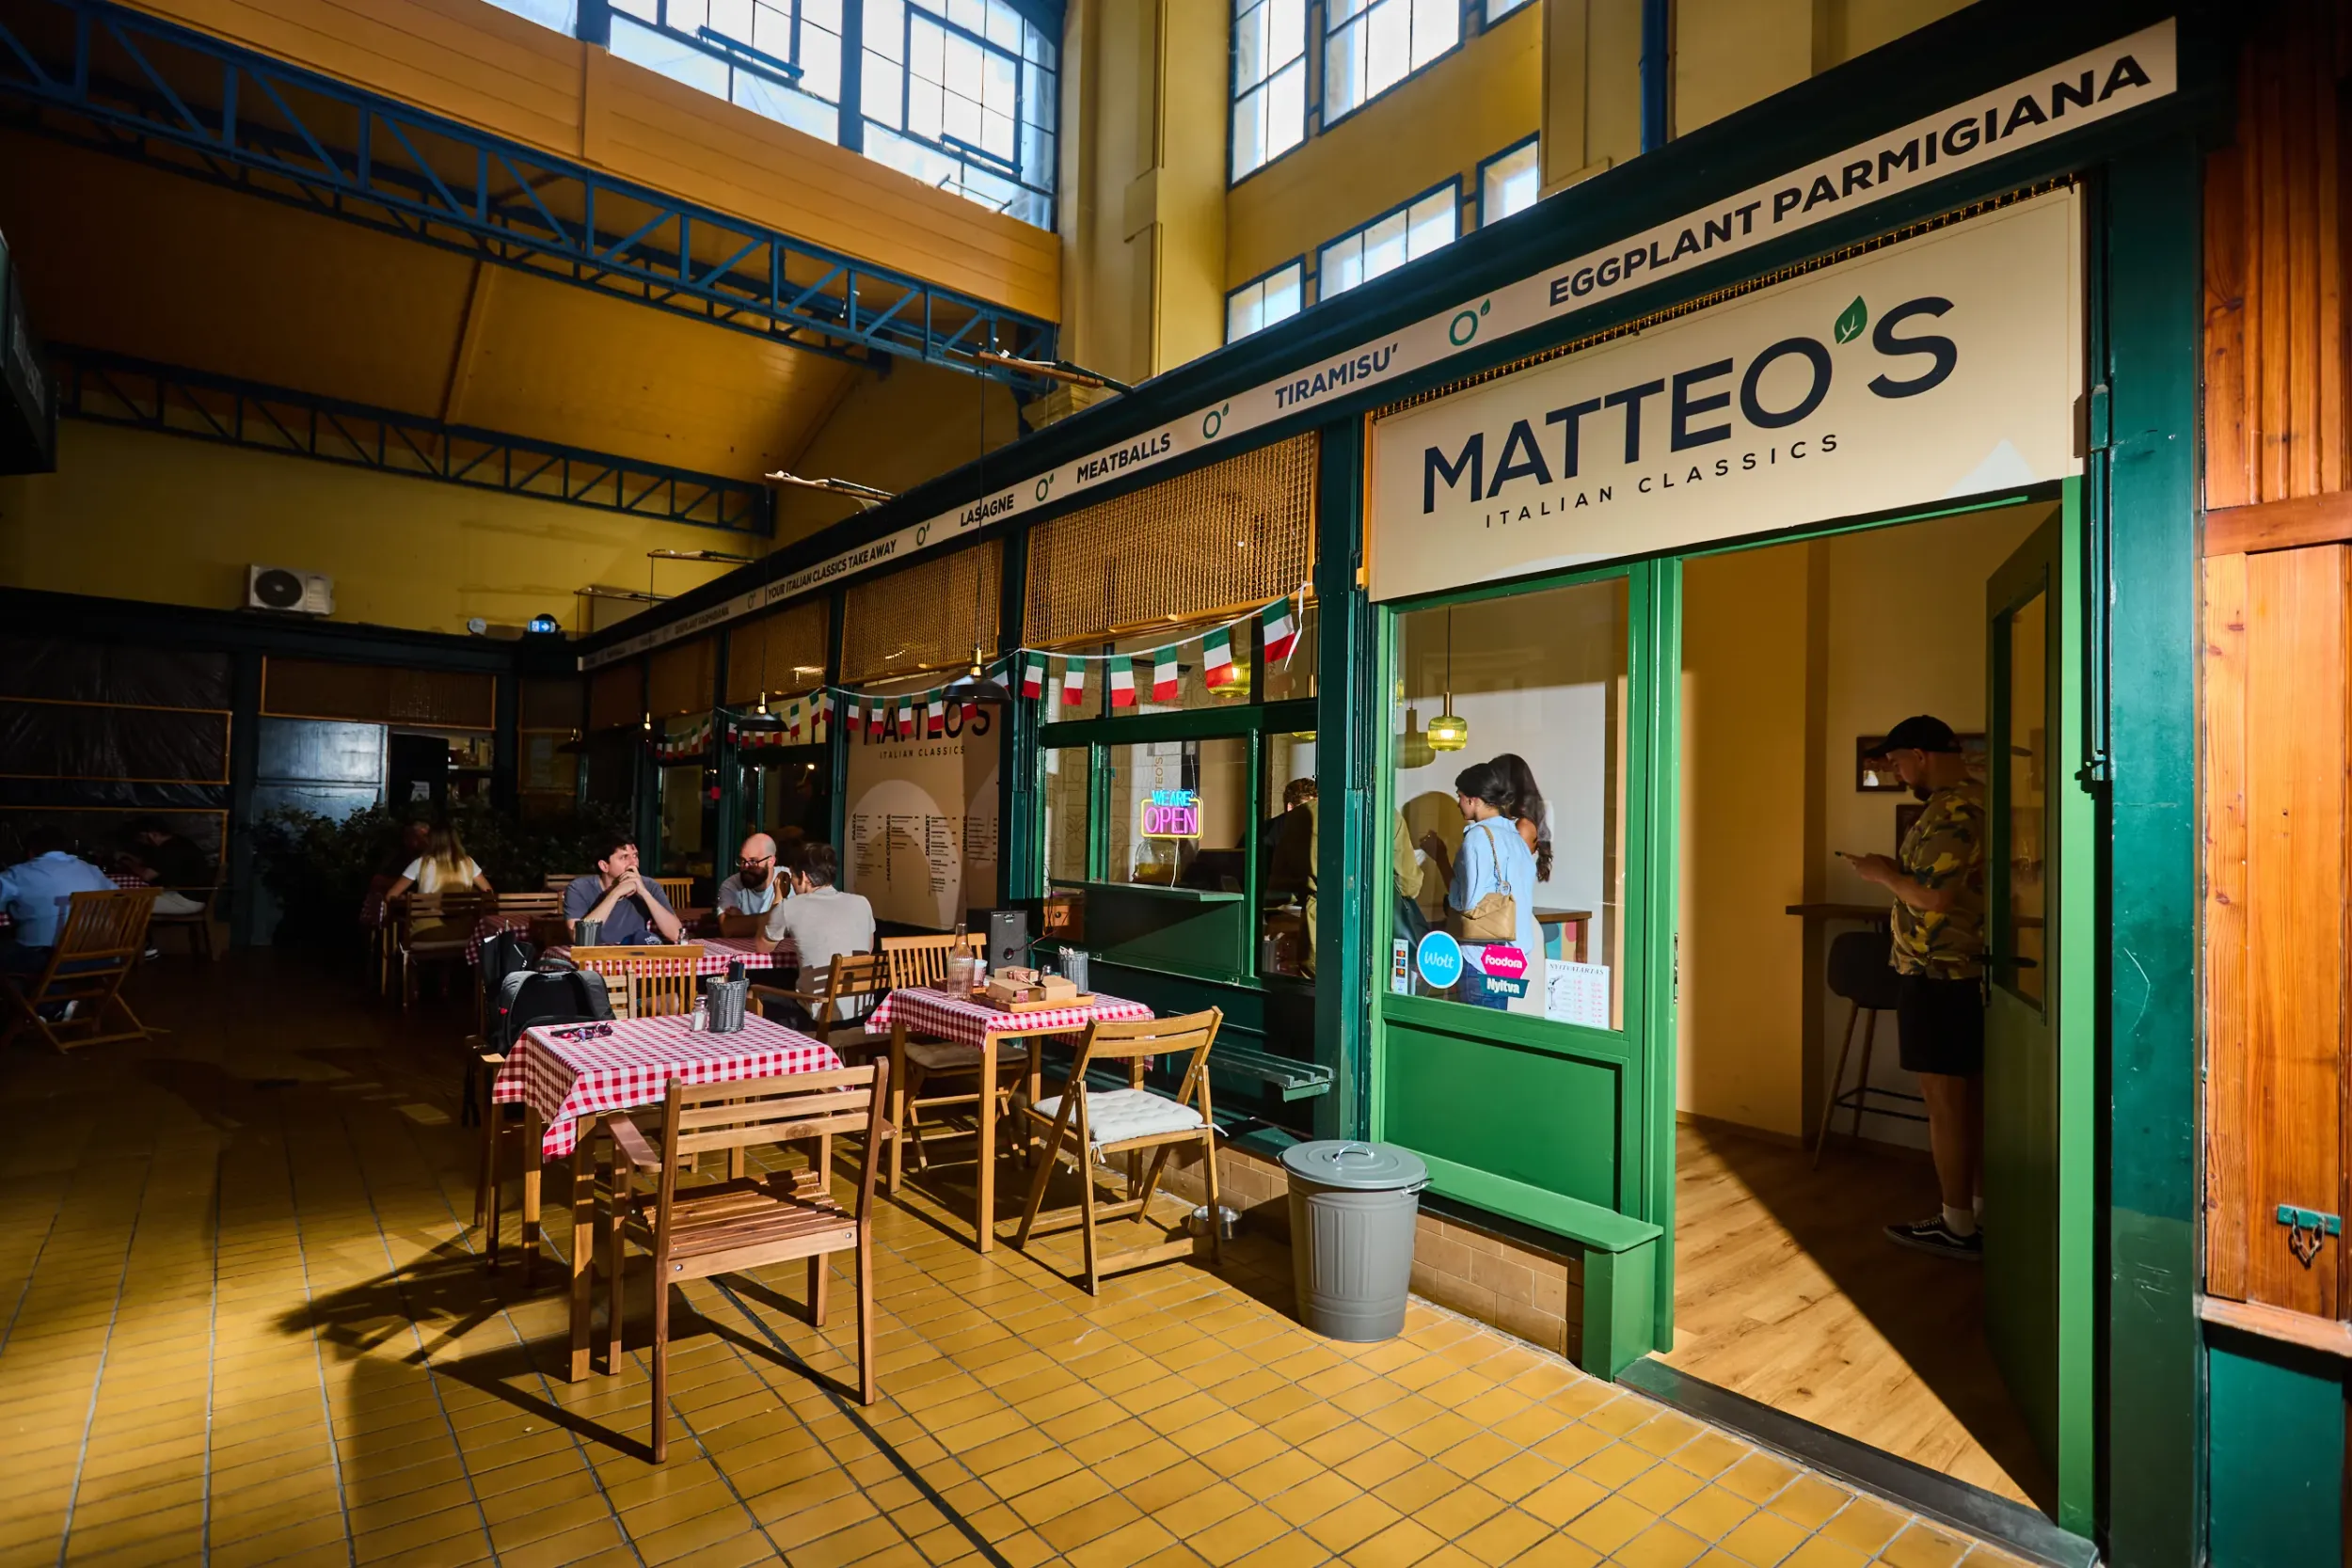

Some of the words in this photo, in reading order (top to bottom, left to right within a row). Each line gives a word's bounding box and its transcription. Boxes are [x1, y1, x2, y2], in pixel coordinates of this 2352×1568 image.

[1549, 201, 1761, 307] EGGPLANT
[1773, 55, 2151, 224] PARMIGIANA
[1423, 295, 1958, 515] MATTEO'S
[1076, 433, 1170, 483] MEATBALLS
[1486, 486, 1613, 529] ITALIAN
[1639, 434, 1838, 494] CLASSICS
[961, 494, 1014, 527] LASAGNE
[768, 584, 785, 600] YOUR
[786, 572, 812, 594] ITALIAN
[812, 559, 847, 583] CLASSICS
[849, 550, 869, 569] TAKE
[869, 539, 897, 562] AWAY
[880, 750, 914, 760] ITALIAN
[918, 745, 965, 757] CLASSICS
[1152, 791, 1169, 806] WE
[1169, 790, 1192, 806] ARE
[1144, 807, 1197, 834] OPEN
[1424, 951, 1454, 969] Wolt
[1485, 955, 1523, 969] foodora
[1486, 977, 1520, 994] Nyitva
